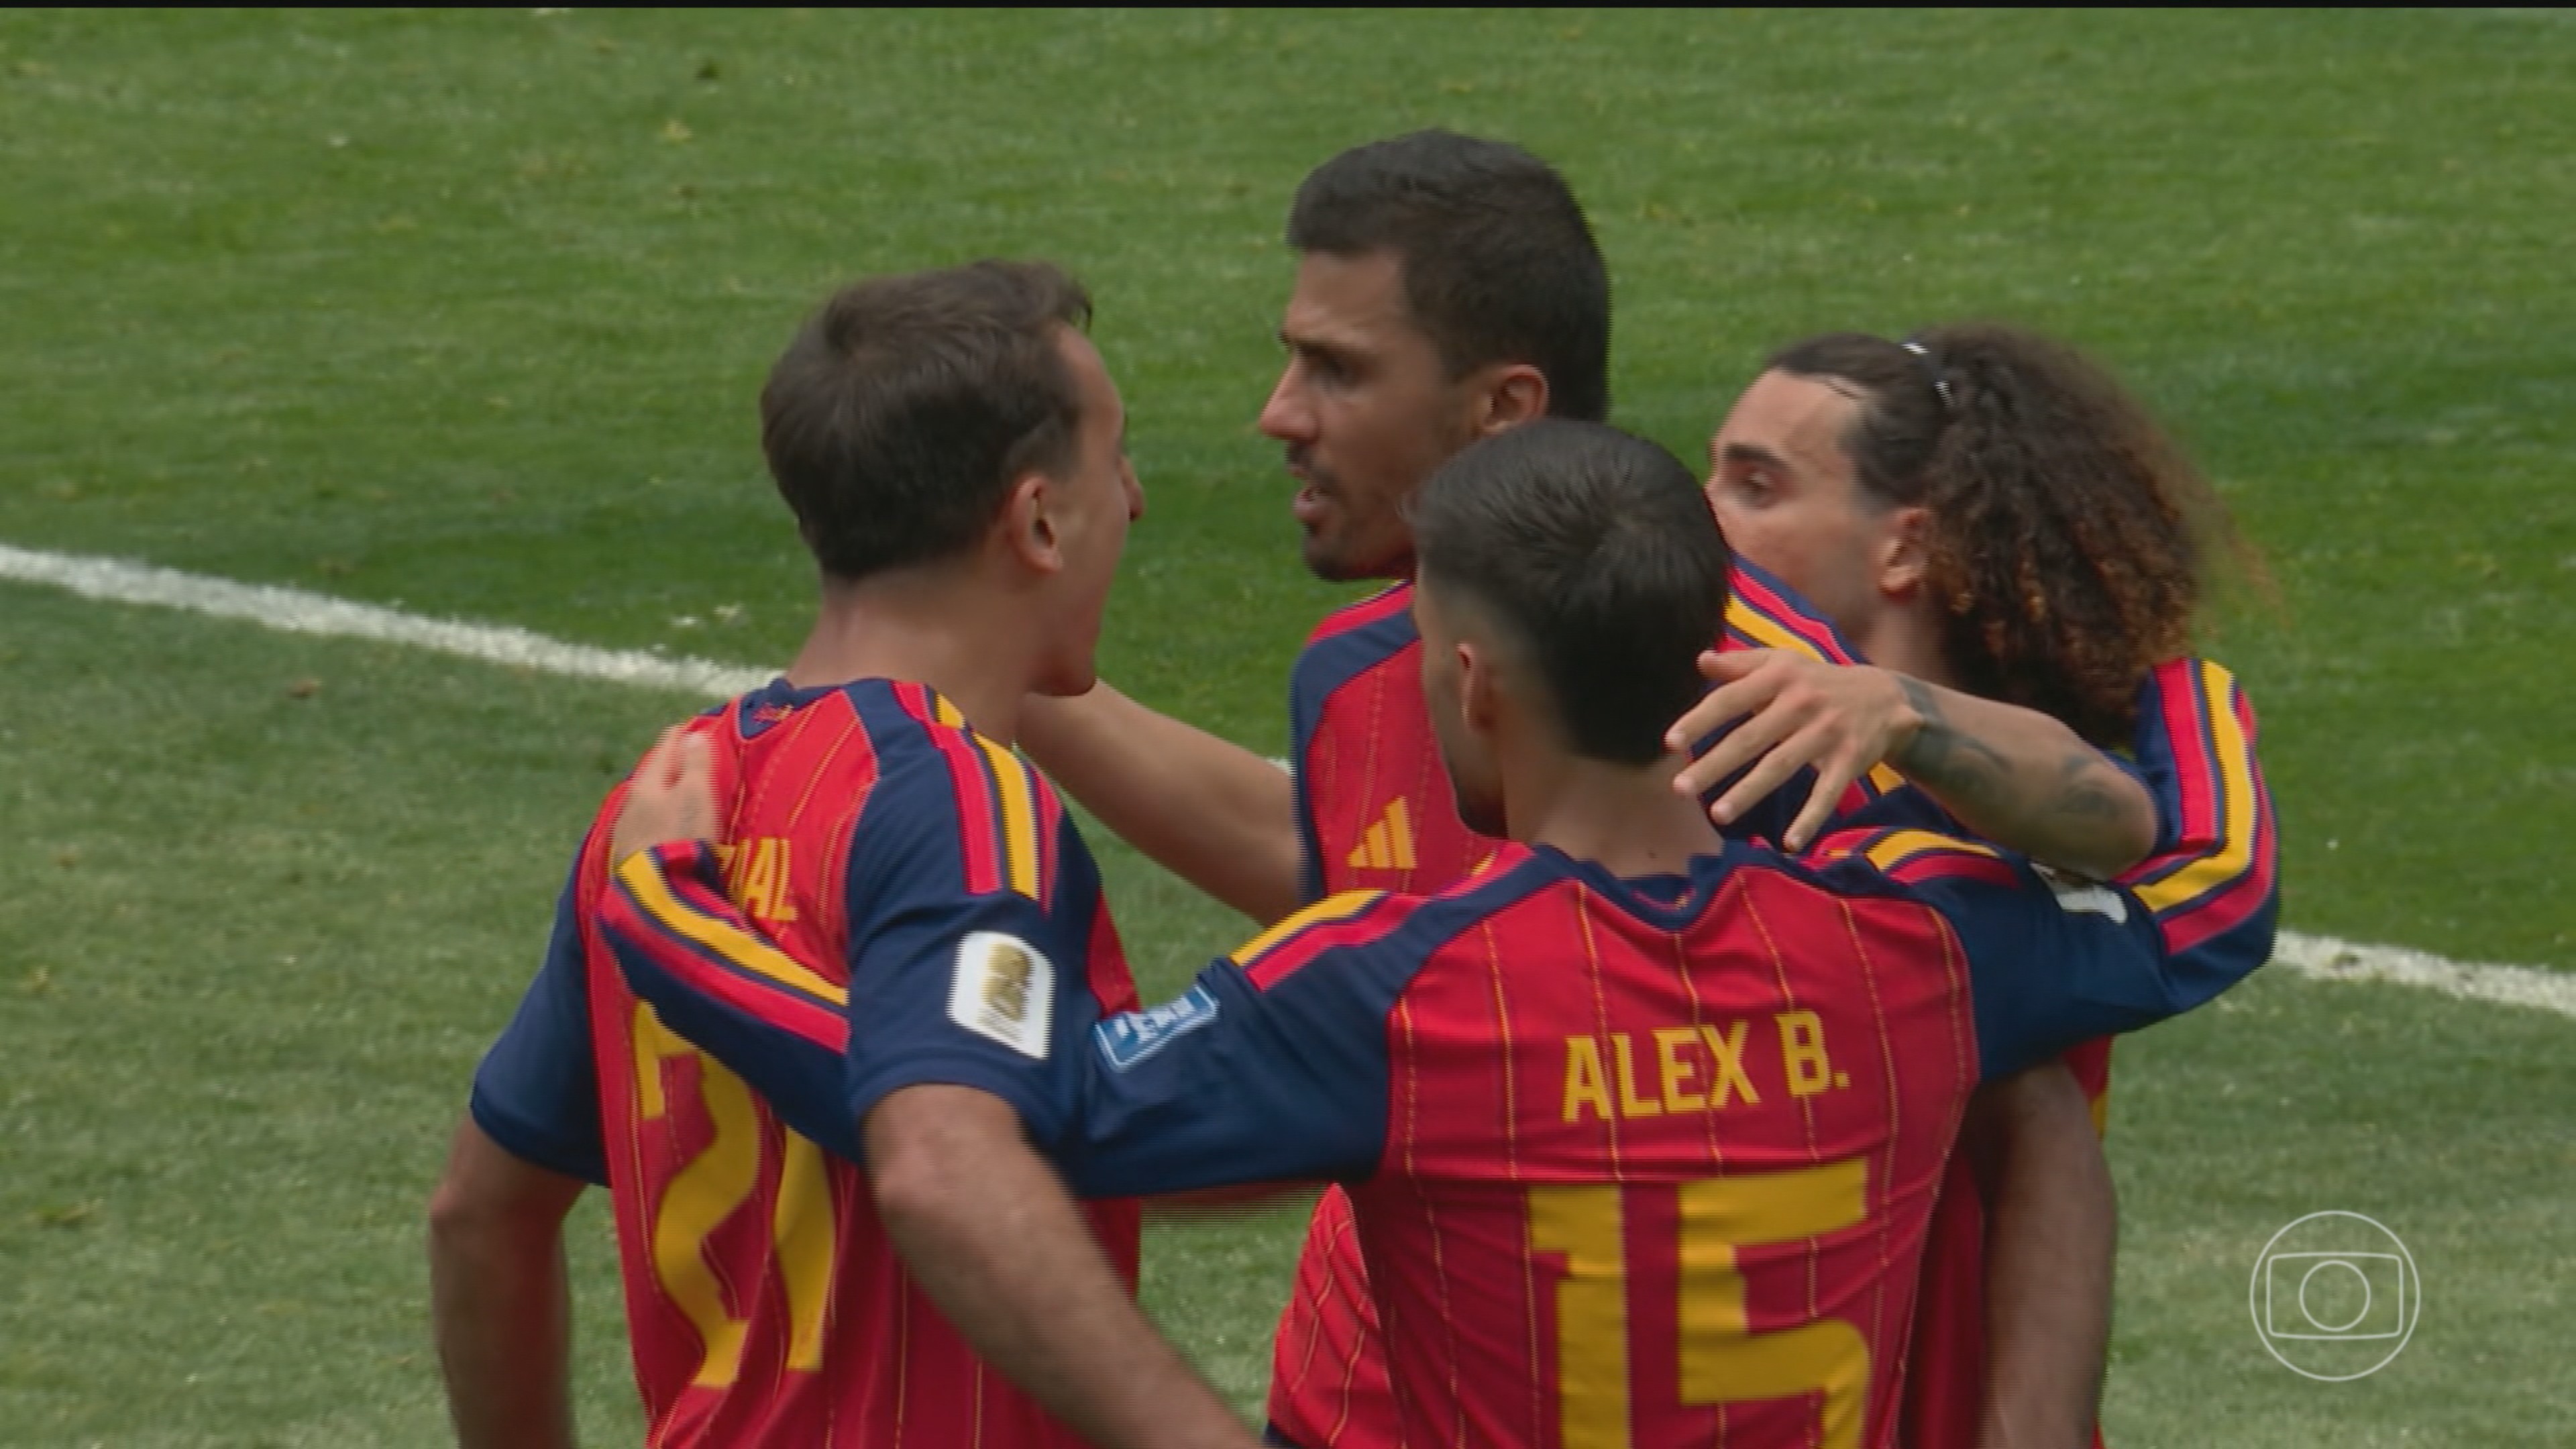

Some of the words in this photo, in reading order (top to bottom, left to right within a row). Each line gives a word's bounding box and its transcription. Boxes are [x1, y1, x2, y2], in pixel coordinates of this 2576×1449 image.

[1562, 1020, 1762, 1122] ALEX
[1776, 1010, 1851, 1096] B.
[1527, 1157, 1870, 1449] 15
